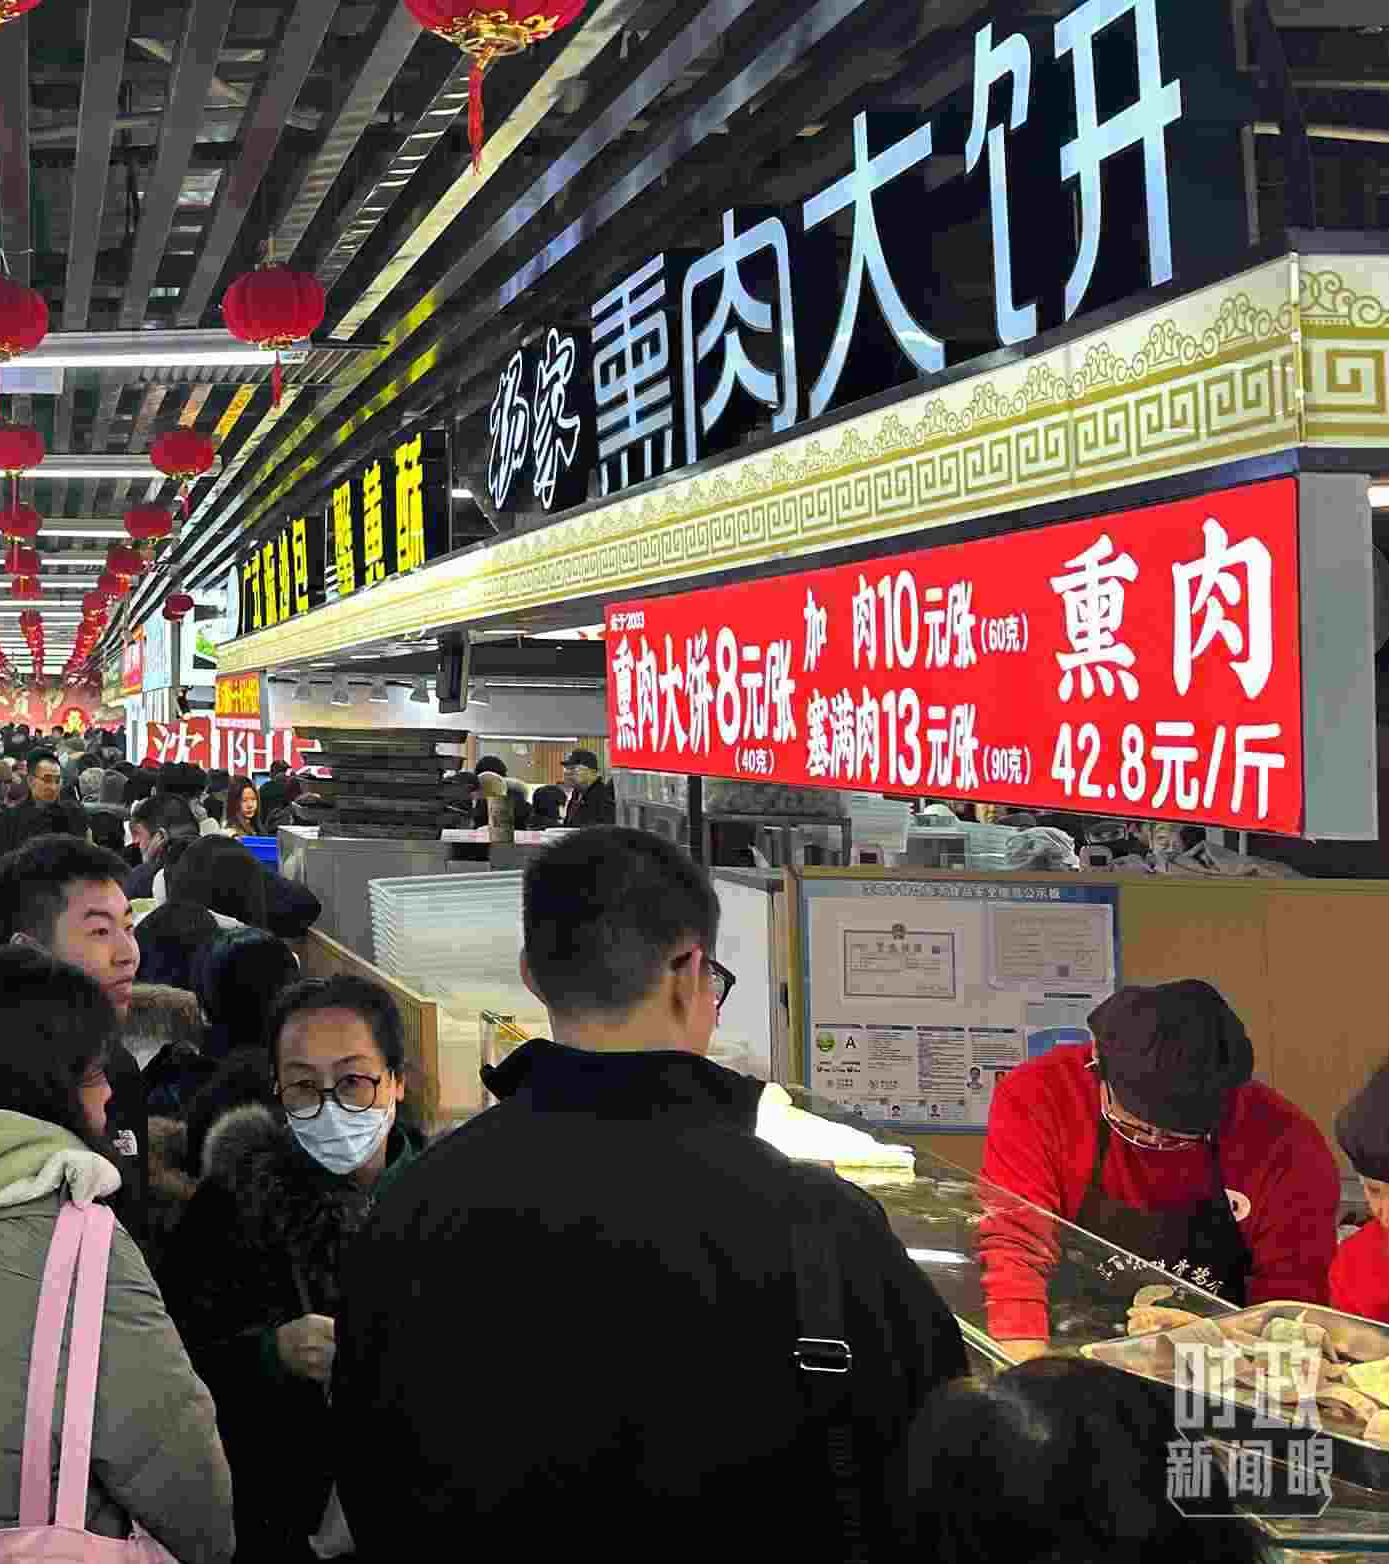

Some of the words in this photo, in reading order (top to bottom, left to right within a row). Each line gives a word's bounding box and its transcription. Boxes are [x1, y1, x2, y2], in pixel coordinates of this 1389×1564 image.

[592, 0, 1182, 496] 熏肉大饼
[1049, 516, 1273, 702] 熏肉
[1052, 720, 1284, 819] 42.8元/斤
